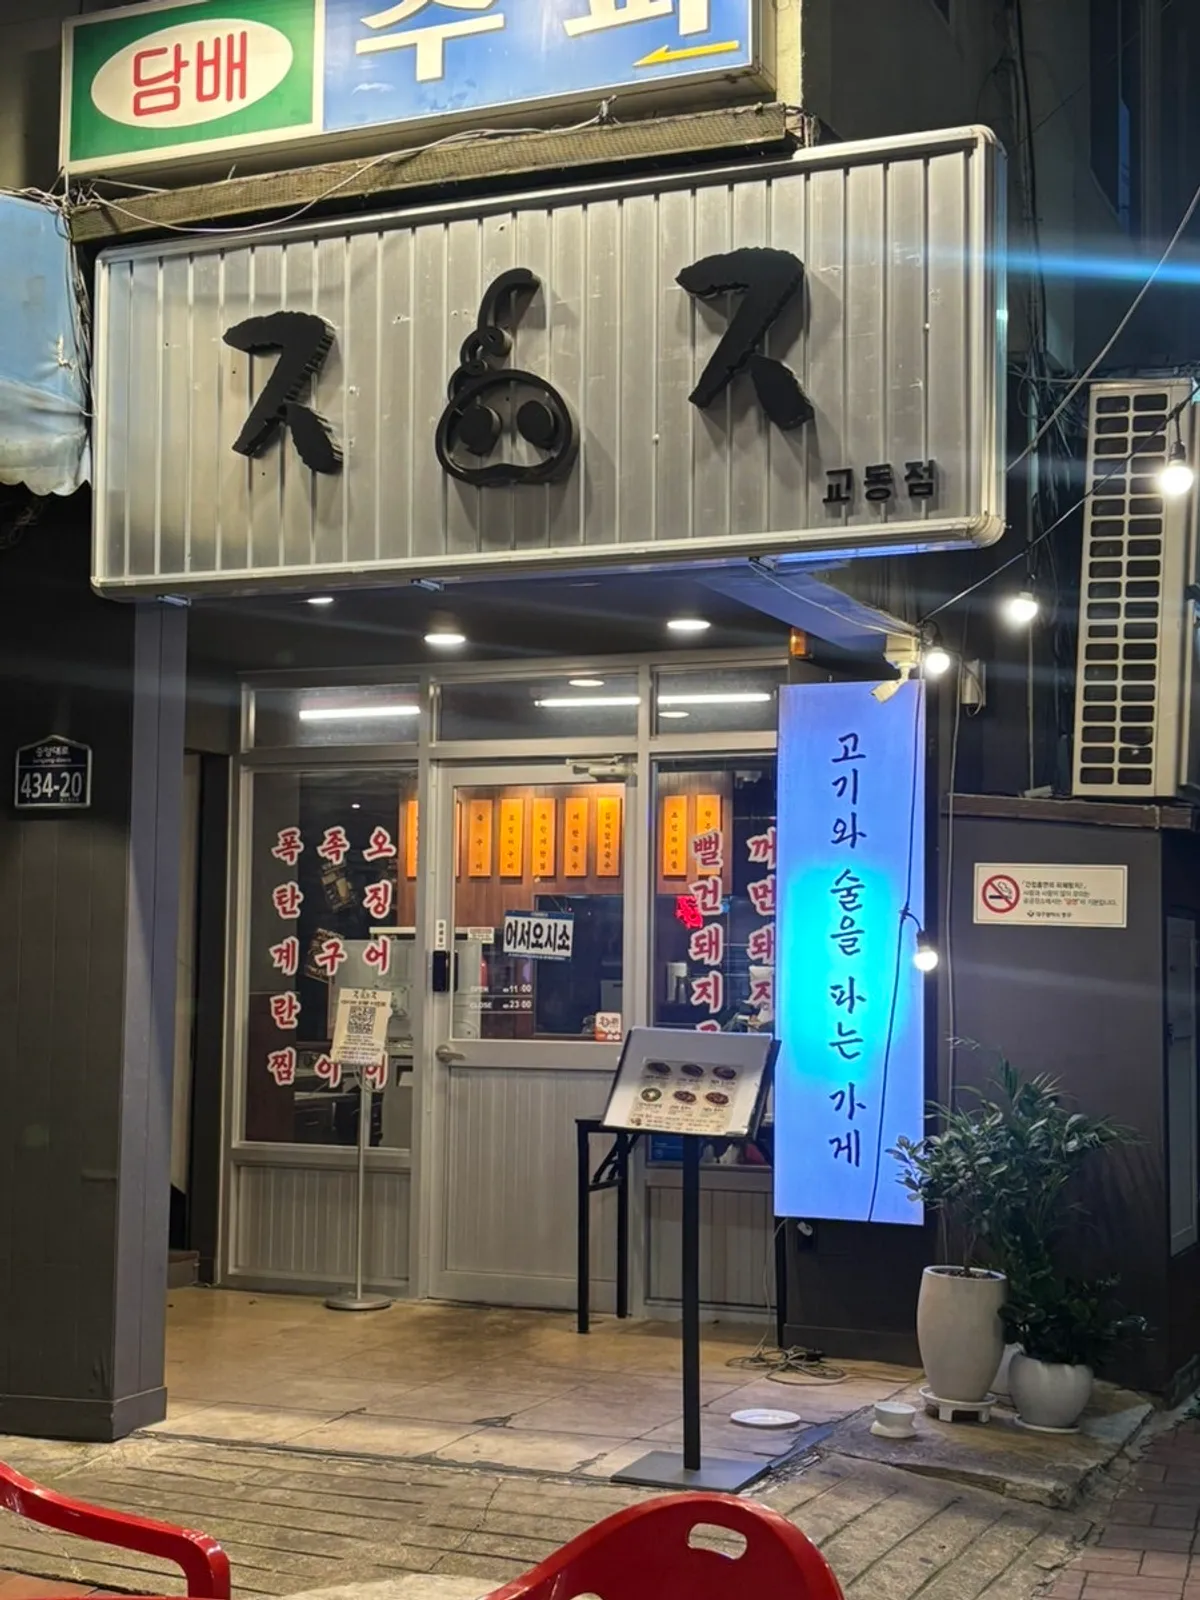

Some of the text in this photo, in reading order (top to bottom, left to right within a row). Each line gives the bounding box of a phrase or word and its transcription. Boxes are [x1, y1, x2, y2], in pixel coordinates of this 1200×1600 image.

[133, 31, 247, 116] 담배
[822, 459, 936, 503] 교동점
[21, 771, 82, 799] 434-20
[269, 828, 303, 1085] 폭탄계란찜
[504, 919, 571, 953] 어서오시소
[829, 732, 867, 1168] 고기와 술을 파는 가게
